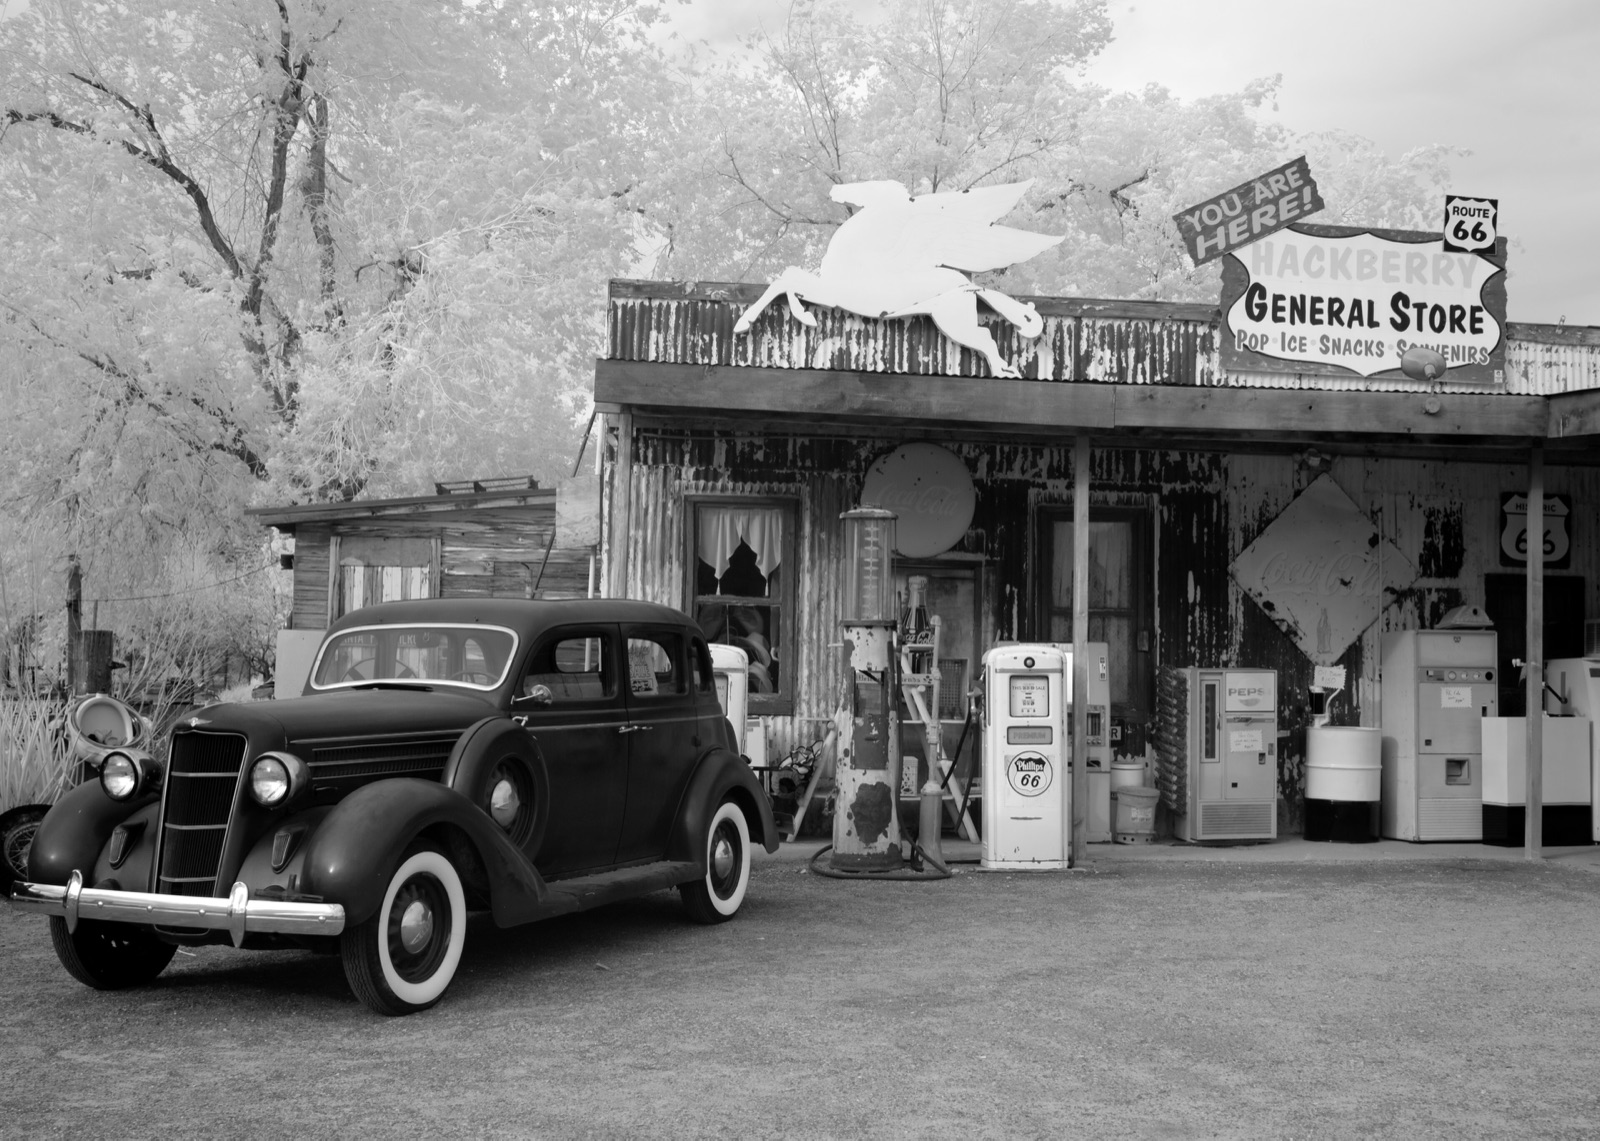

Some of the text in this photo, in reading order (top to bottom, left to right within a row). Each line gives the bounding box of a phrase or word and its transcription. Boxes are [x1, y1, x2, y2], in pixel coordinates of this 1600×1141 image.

[1186, 166, 1303, 231] YOU ARE
[1196, 186, 1312, 257] HERE!
[1452, 206, 1490, 219] ROUTE
[1452, 220, 1487, 242] 66
[1251, 242, 1478, 289] HACKBERRY
[1245, 282, 1484, 335] GENERAL STORE
[1235, 329, 1490, 364] POP ICE SNACKS SVENIRS
[1515, 502, 1556, 512] HIRIC
[1515, 528, 1556, 555] 66
[1228, 687, 1270, 696] PEPS
[1016, 760, 1044, 772] Phillips
[1021, 774, 1041, 788] 66
